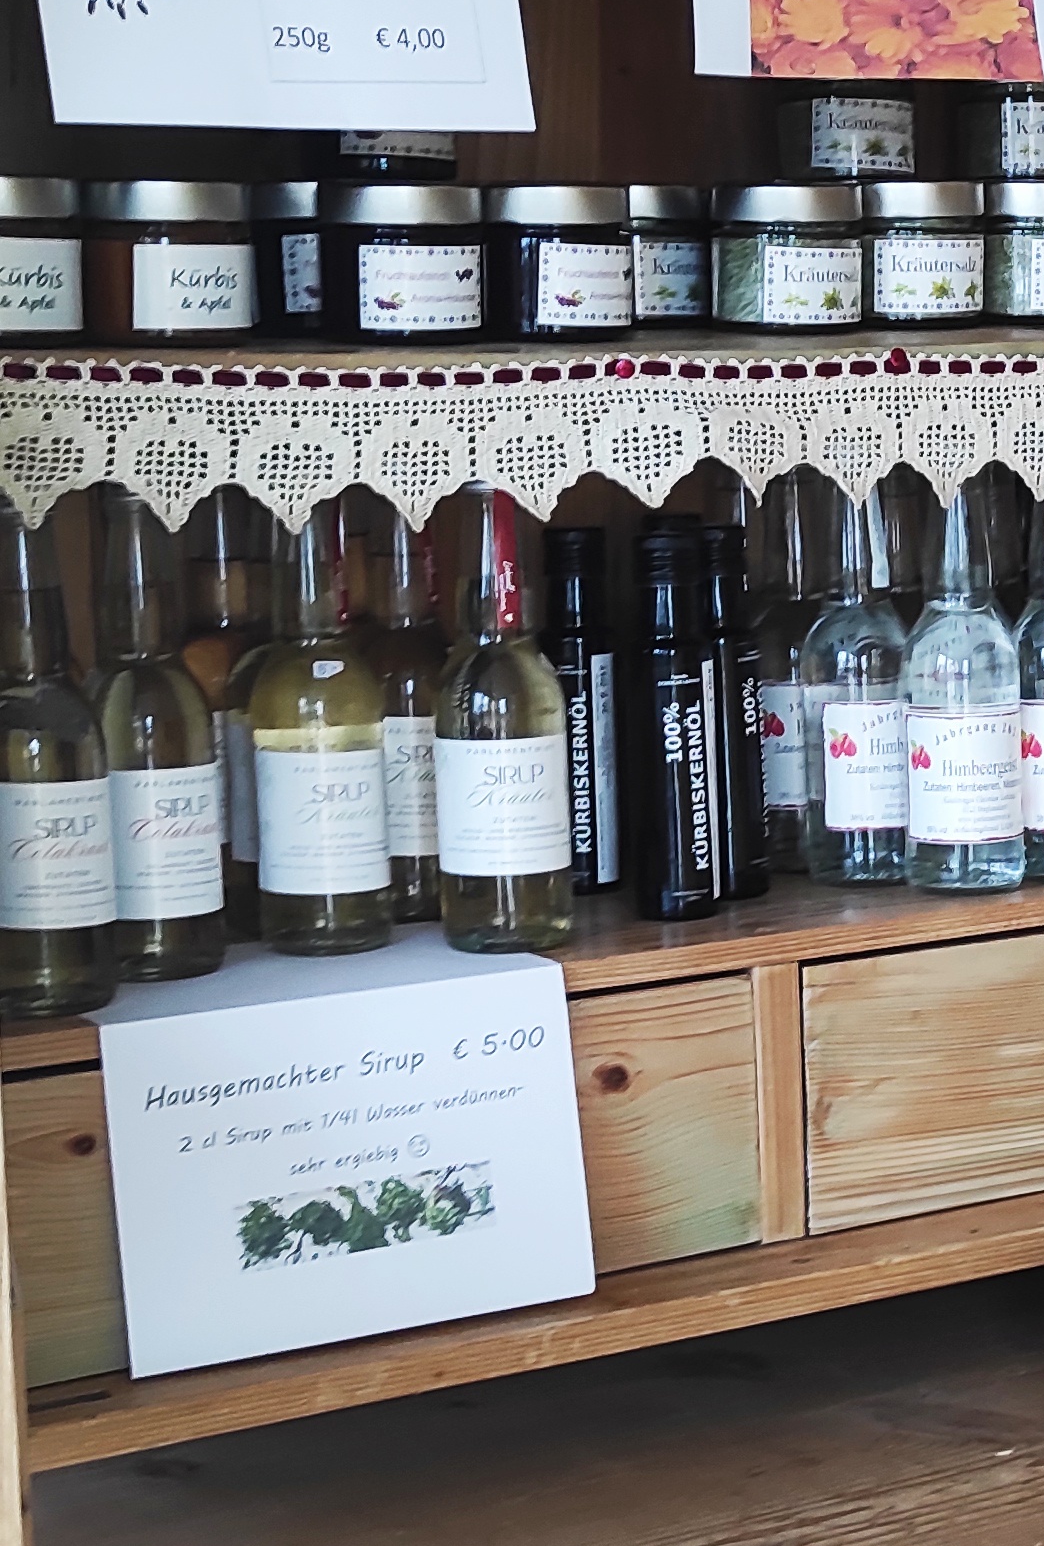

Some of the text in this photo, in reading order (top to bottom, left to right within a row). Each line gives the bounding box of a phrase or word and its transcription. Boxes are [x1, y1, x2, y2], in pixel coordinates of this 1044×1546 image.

[272, 26, 445, 53] 250g € 4,00
[170, 265, 239, 290] Kürbis
[181, 296, 194, 310] &
[741, 677, 758, 738] 100%
[660, 701, 683, 765] 100%
[869, 736, 904, 756] Himb
[935, 722, 997, 746] Jahrgang
[475, 763, 544, 788] SIRUP
[567, 690, 593, 854] KÜRBISKERNÖL
[683, 699, 710, 871] KÜRBISKERNÖL
[152, 793, 209, 820] SIRUP
[308, 781, 371, 806] SIRUP
[34, 814, 98, 840] SIRUP
[144, 1063, 346, 1112] Hausgemachter
[360, 1050, 425, 1077] Sirup
[453, 1038, 469, 1061] €
[178, 1135, 193, 1154] 2
[202, 1131, 217, 1150] cl
[225, 1126, 272, 1144] Sirup
[281, 1119, 313, 1136] mit
[367, 1101, 425, 1123] Wasser
[288, 1144, 399, 1176] sehr ergiebig
